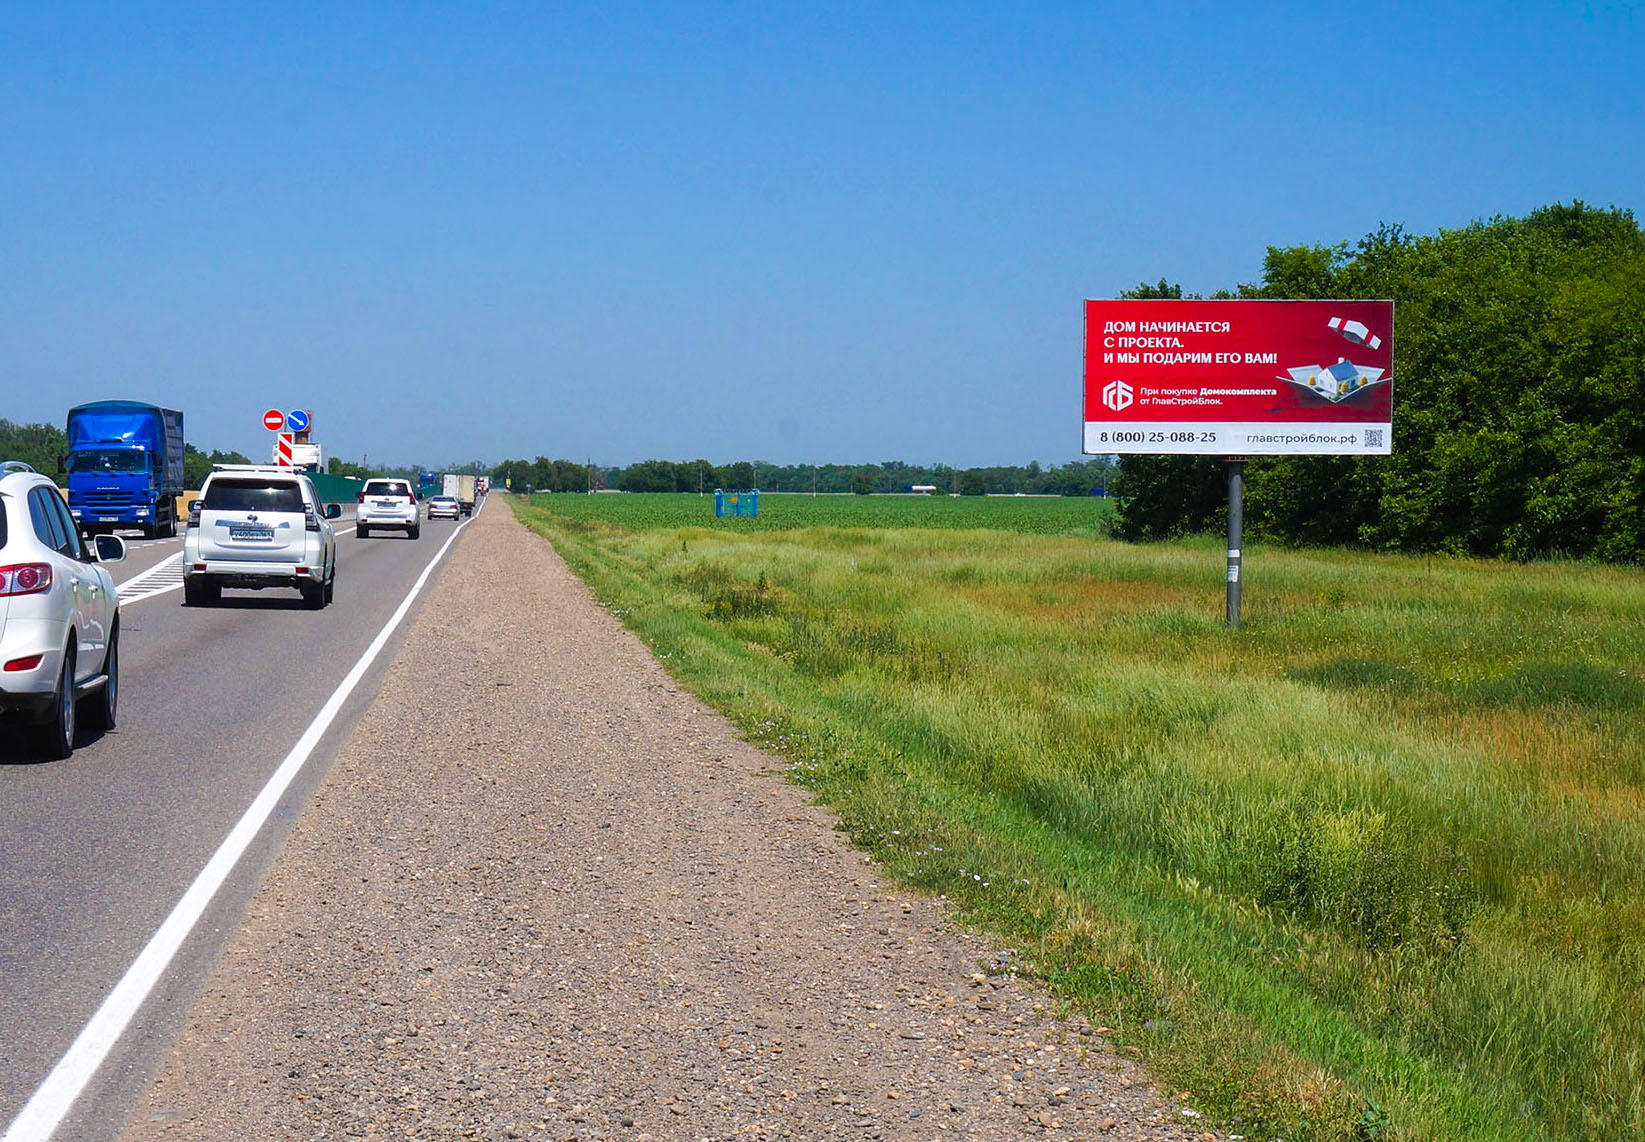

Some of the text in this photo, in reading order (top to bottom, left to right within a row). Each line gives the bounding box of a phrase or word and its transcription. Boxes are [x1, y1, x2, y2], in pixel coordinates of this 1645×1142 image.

[1103, 322, 1230, 333] ДОМ НАЧИНАЕТСЯ
[1103, 337, 1184, 348] С ПРОЕКТА.
[1103, 353, 1277, 366] И МЫ ПОДАРИМ ЕГО ВАМ!
[1139, 387, 1277, 398] При покупке Домокомплекта
[1152, 396, 1223, 406] ГлавСтройБлок.
[1100, 430, 1217, 444] 8 (800) 25-088-25
[1246, 432, 1358, 445] главстройблок.рф
